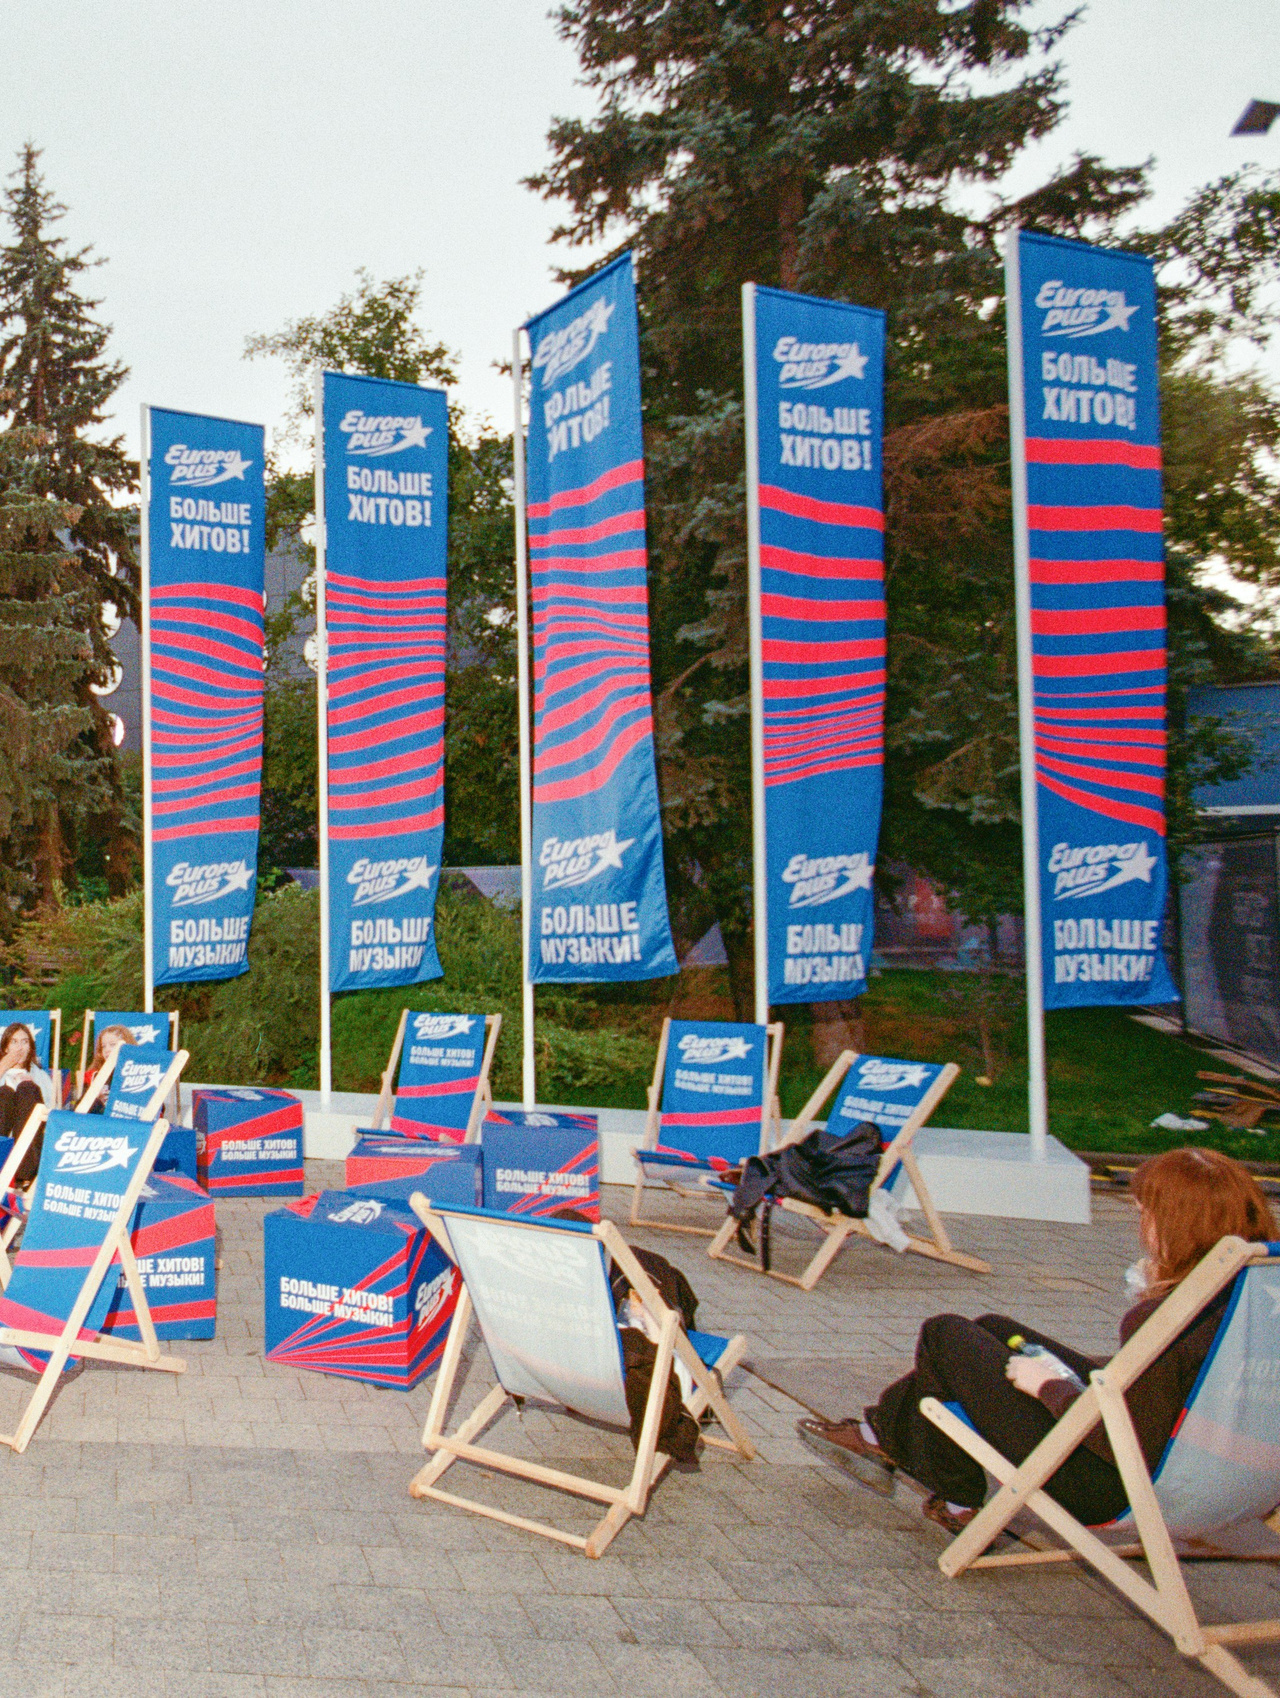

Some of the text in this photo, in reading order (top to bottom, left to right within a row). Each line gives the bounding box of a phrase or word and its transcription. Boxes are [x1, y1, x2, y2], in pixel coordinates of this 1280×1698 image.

[1035, 280, 1125, 308] Europa
[773, 336, 856, 362] Europa
[1042, 350, 1138, 393] БОЛЬШЕ
[339, 410, 420, 433] Europa
[779, 401, 872, 435] БОЛЬШЕ
[164, 444, 239, 466] Europa
[779, 434, 872, 470] ХИТОВ!
[347, 465, 433, 497] БОЛЬШЕ
[170, 496, 252, 525] БОЛЬШЕ
[347, 493, 432, 527] ХИТОВ!
[170, 522, 250, 553] ХИТОВ!
[539, 830, 616, 866] Europa
[1048, 841, 1145, 873] Europa
[166, 861, 242, 886] Europa
[347, 856, 422, 884] Europa
[170, 916, 249, 943] БОЛЬШЕ
[541, 900, 640, 936] БОЛЬШЕ
[540, 933, 642, 964] МУЗЫКИ!
[786, 923, 864, 955] БОЛЬШ
[169, 942, 246, 968] МУЗЫКИ!
[54, 1131, 124, 1152] Europa
[221, 1139, 297, 1151] БОЛЬШЕ ХИТОВ!
[221, 1150, 258, 1161] БОЛЬШЕ
[496, 1168, 590, 1186] БОЛЬШЕ ХИТОВ!
[496, 1181, 541, 1194] БОЛЬШЕ
[46, 1182, 92, 1205] БОЛЬШЕ
[43, 1199, 83, 1219] БОЛЬШЕ
[157, 1257, 205, 1273] ХИТОВ!
[149, 1272, 205, 1287] МУЗЫКИ!
[280, 1276, 394, 1312] БОЛЬШЕ ХИТОВ!
[280, 1293, 394, 1328] БОЛЬШЕ МУЗЫКИ!
